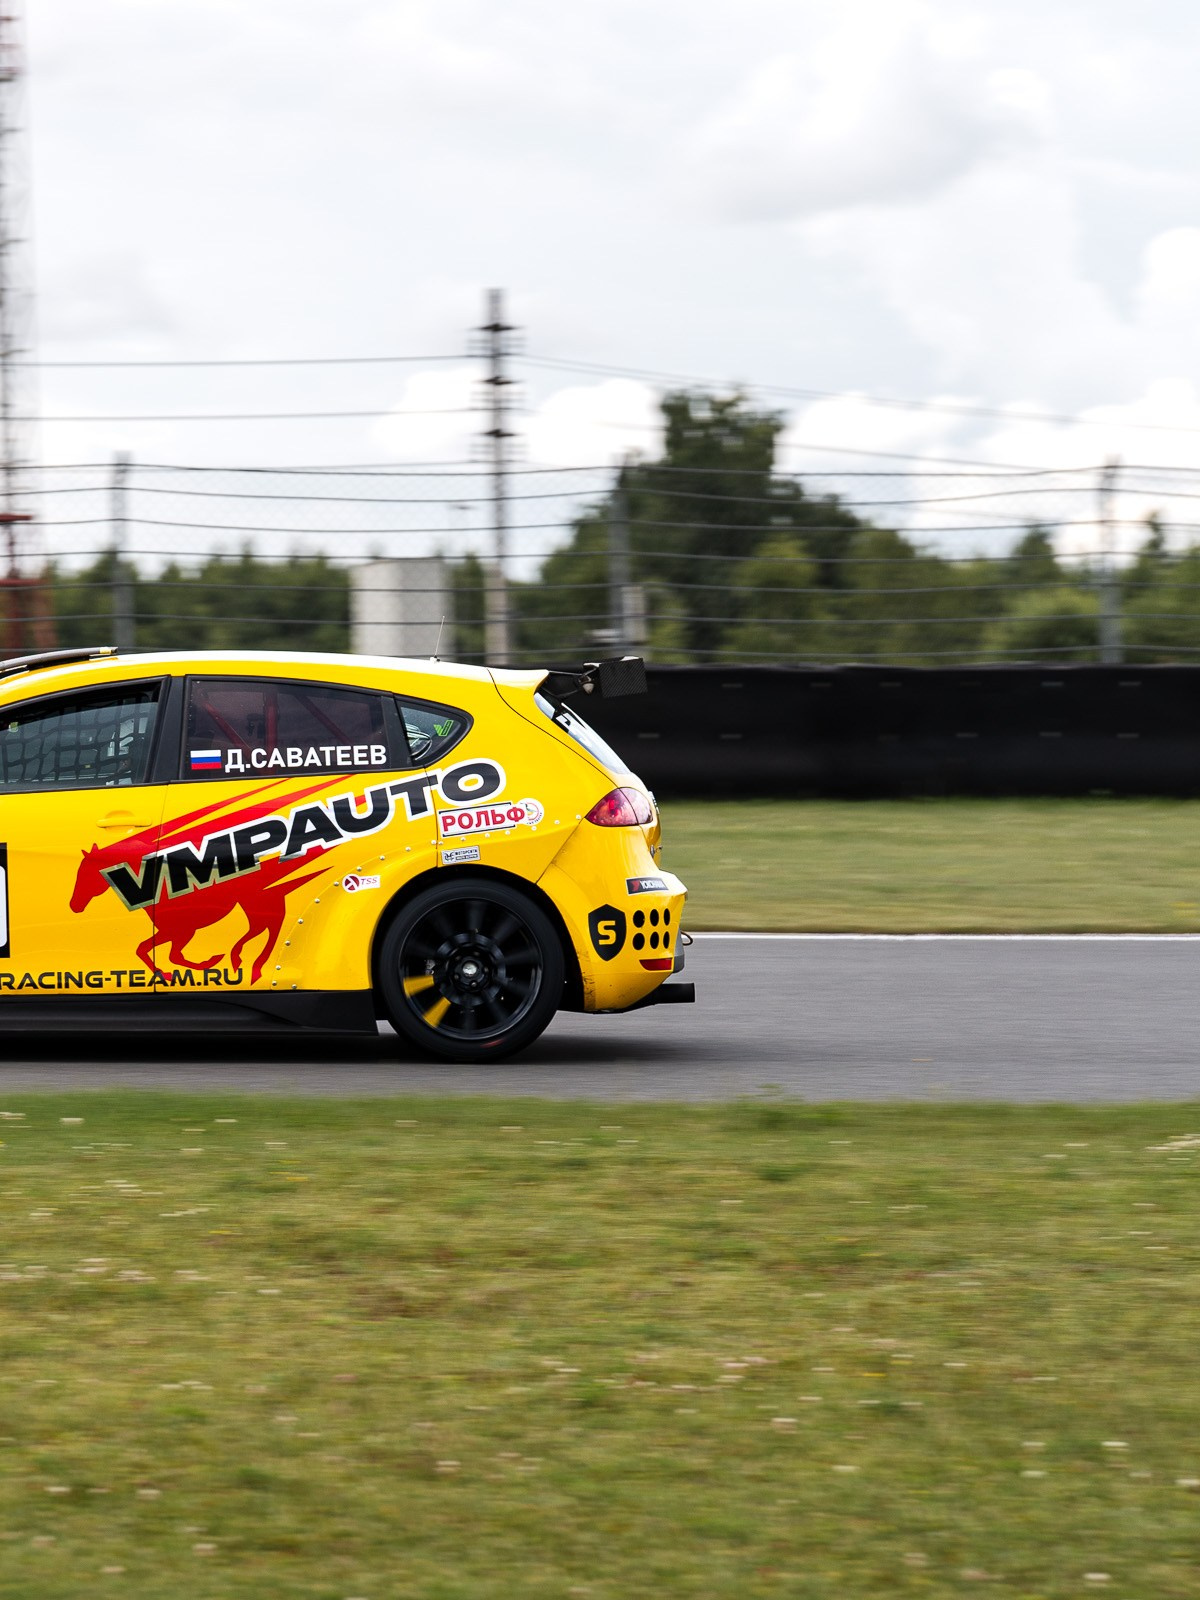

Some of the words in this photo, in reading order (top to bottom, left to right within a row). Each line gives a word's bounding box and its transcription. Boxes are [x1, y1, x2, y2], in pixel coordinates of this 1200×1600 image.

[224, 744, 387, 773] Д.САВАТЕЕВ
[441, 806, 526, 832] РОЛЬФ
[104, 760, 503, 909] VMPAUTO
[360, 877, 378, 885] TSS
